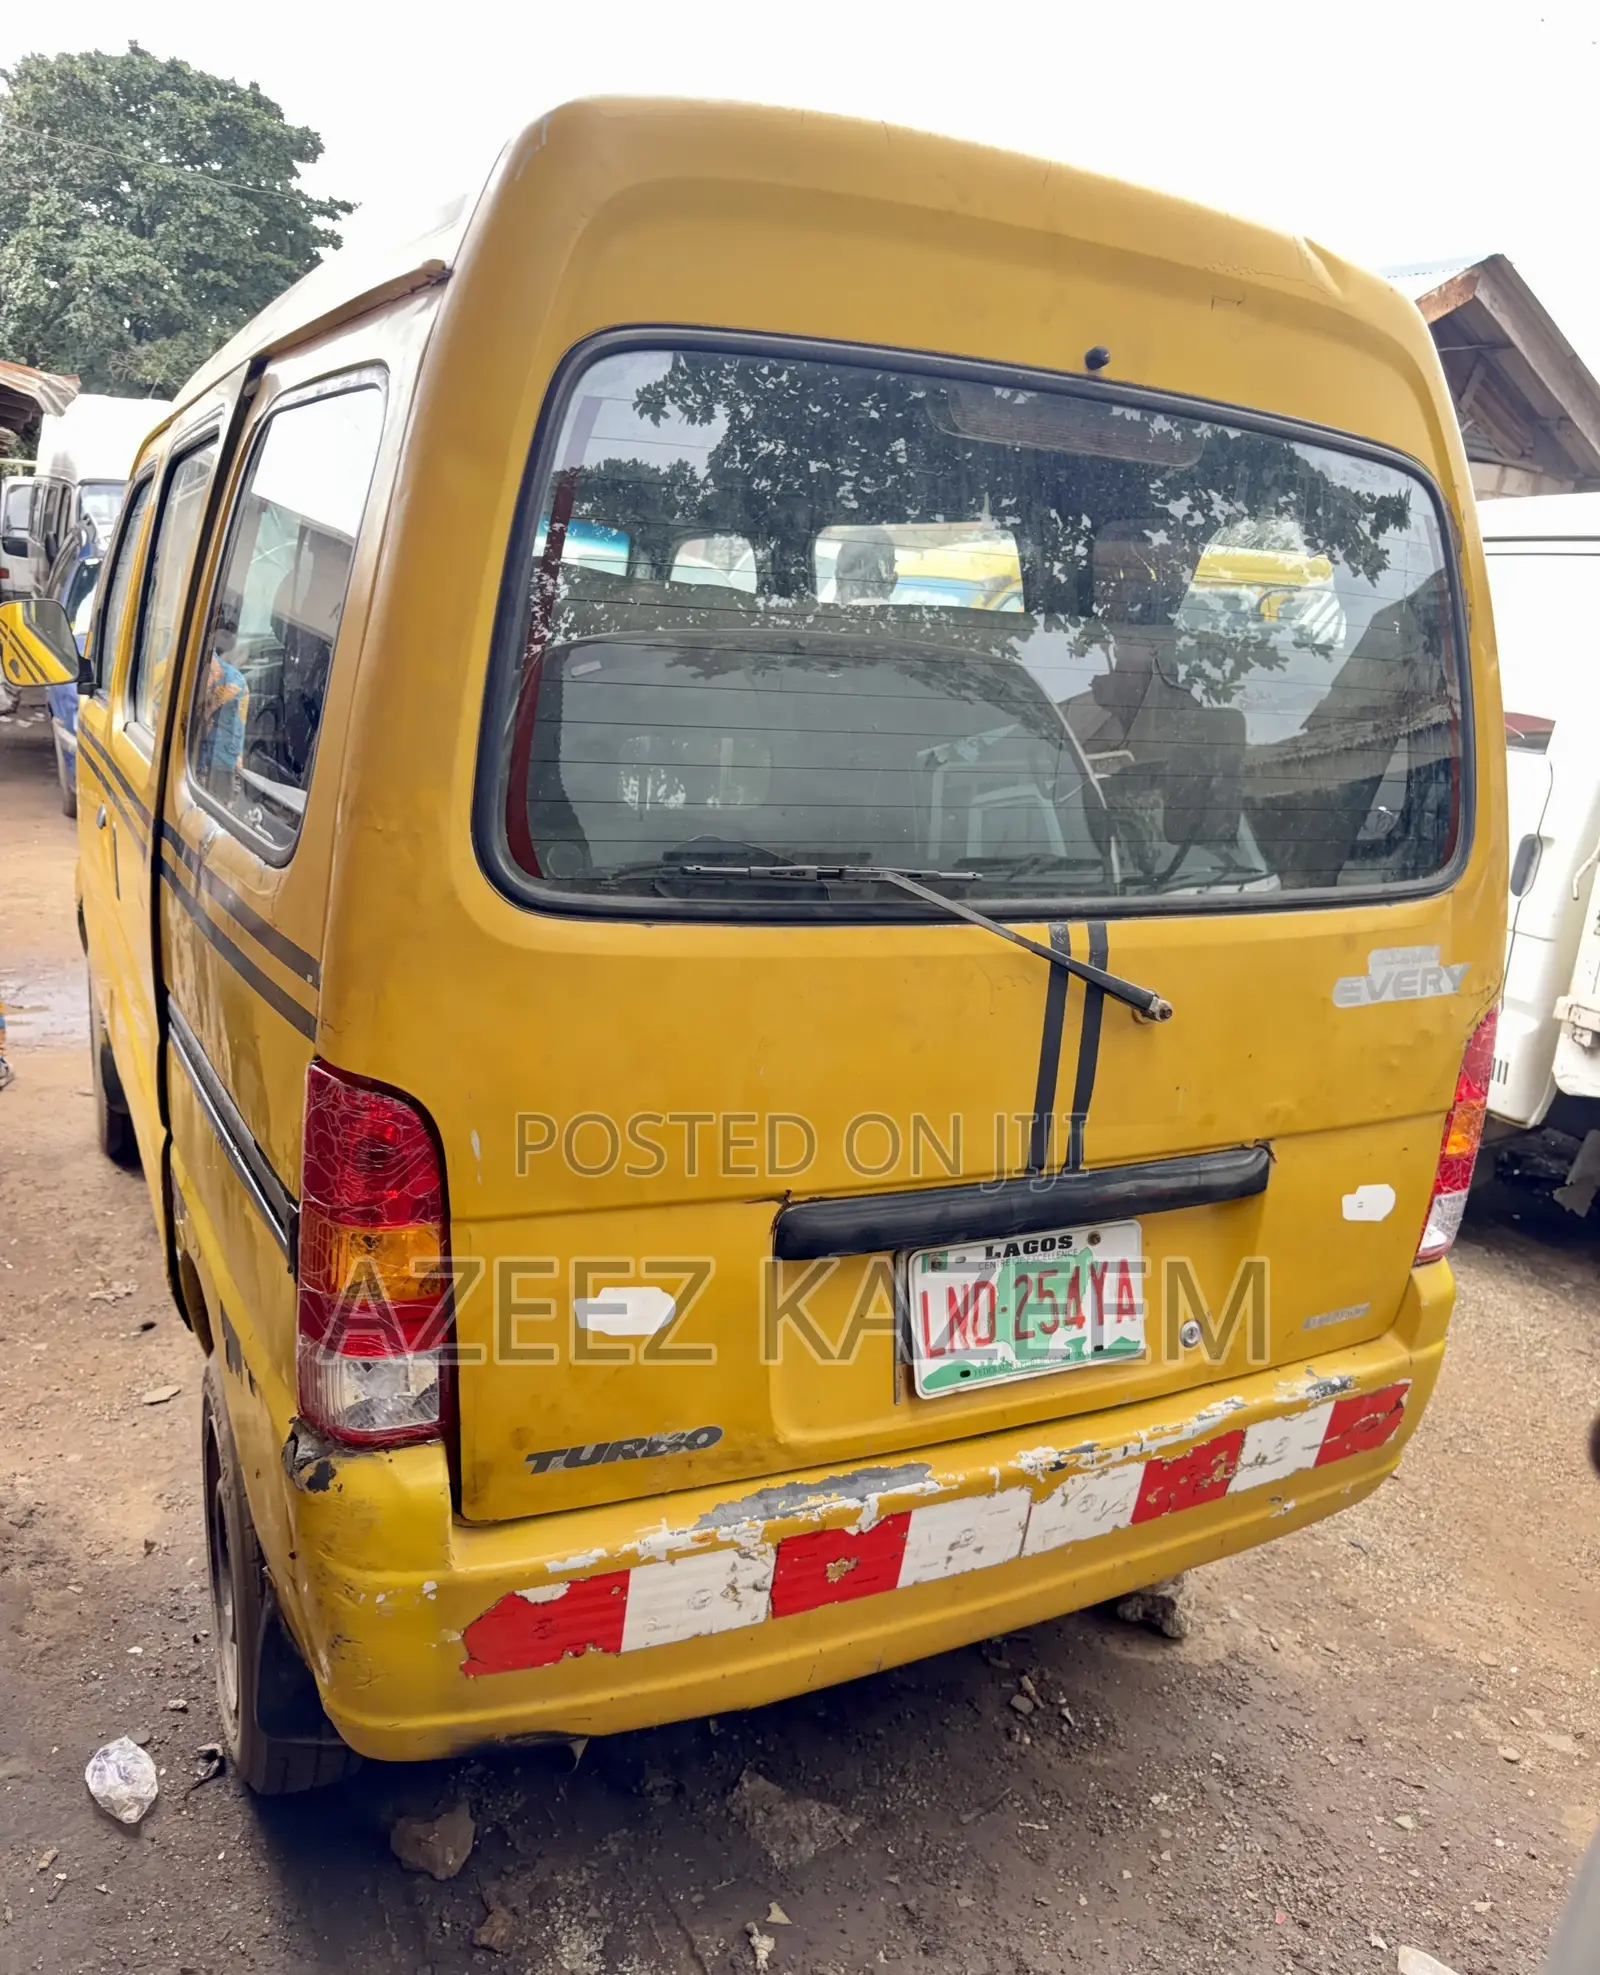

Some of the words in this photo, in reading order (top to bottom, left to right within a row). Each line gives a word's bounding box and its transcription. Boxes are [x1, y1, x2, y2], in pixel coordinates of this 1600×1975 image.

[1335, 963, 1471, 1004] EVERY
[978, 1257, 1011, 1271] CENTRE
[1026, 1248, 1078, 1264] EXCELLENCE
[984, 1235, 1073, 1261] LAGOS
